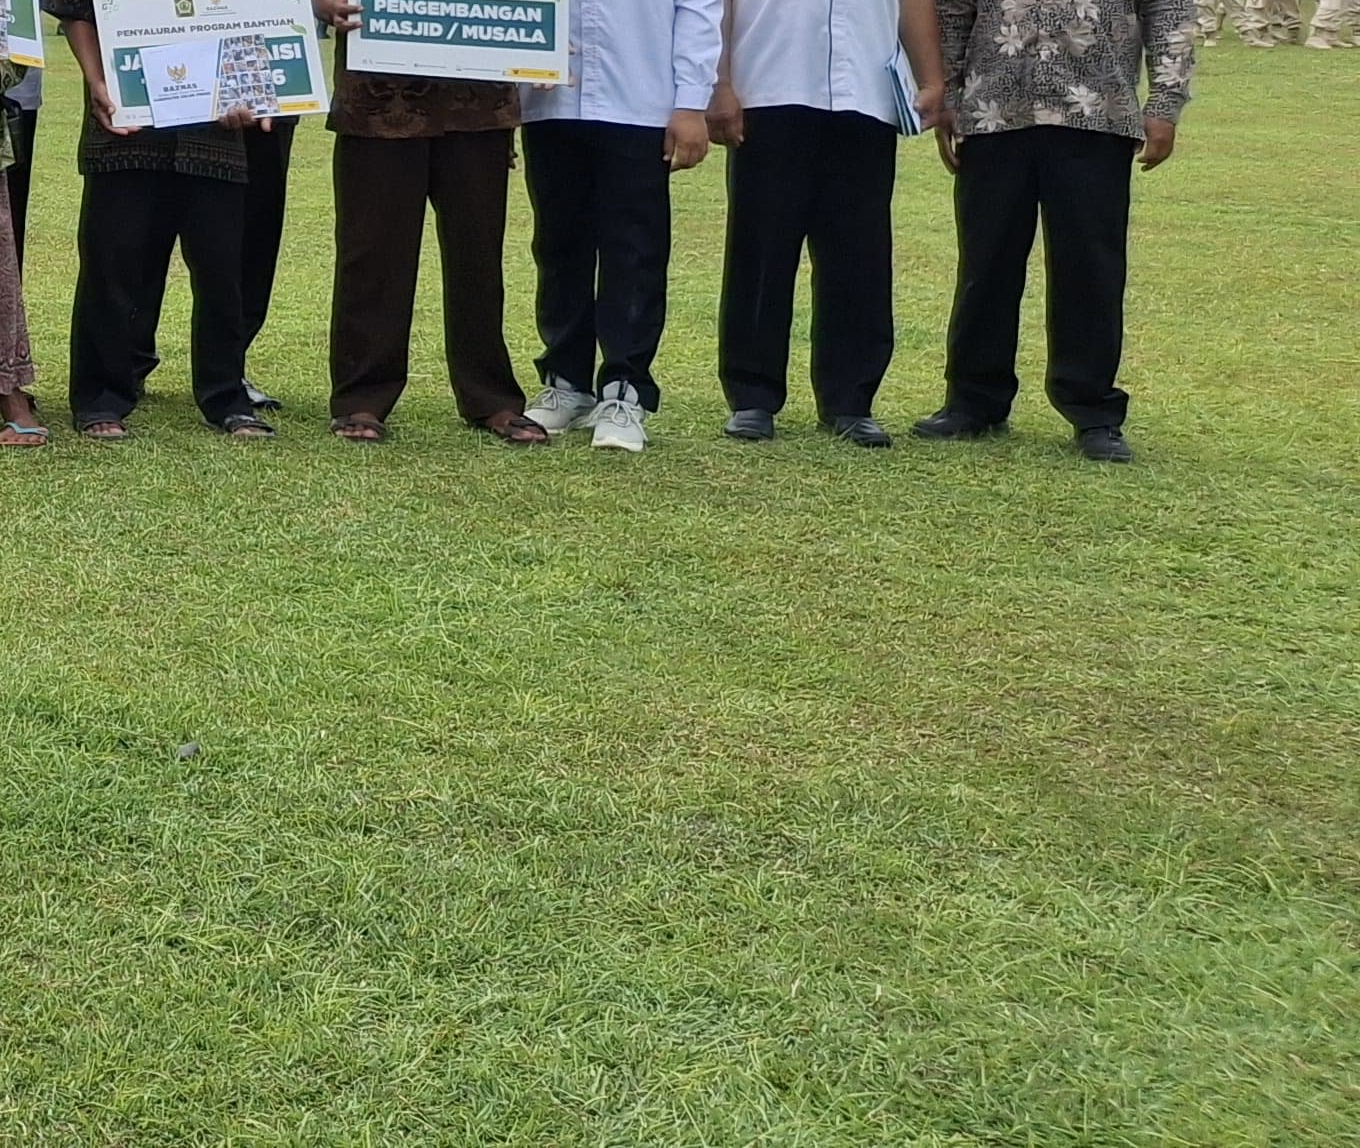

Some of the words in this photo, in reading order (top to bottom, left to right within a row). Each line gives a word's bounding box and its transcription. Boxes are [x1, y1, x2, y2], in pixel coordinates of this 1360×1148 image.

[116, 25, 186, 37] PENYALURAN
[190, 22, 242, 32] PROGRAM
[243, 17, 295, 29] BANTUAN
[369, 18, 443, 38] MASJID
[445, 22, 460, 40] /
[462, 24, 547, 45] MUSALA
